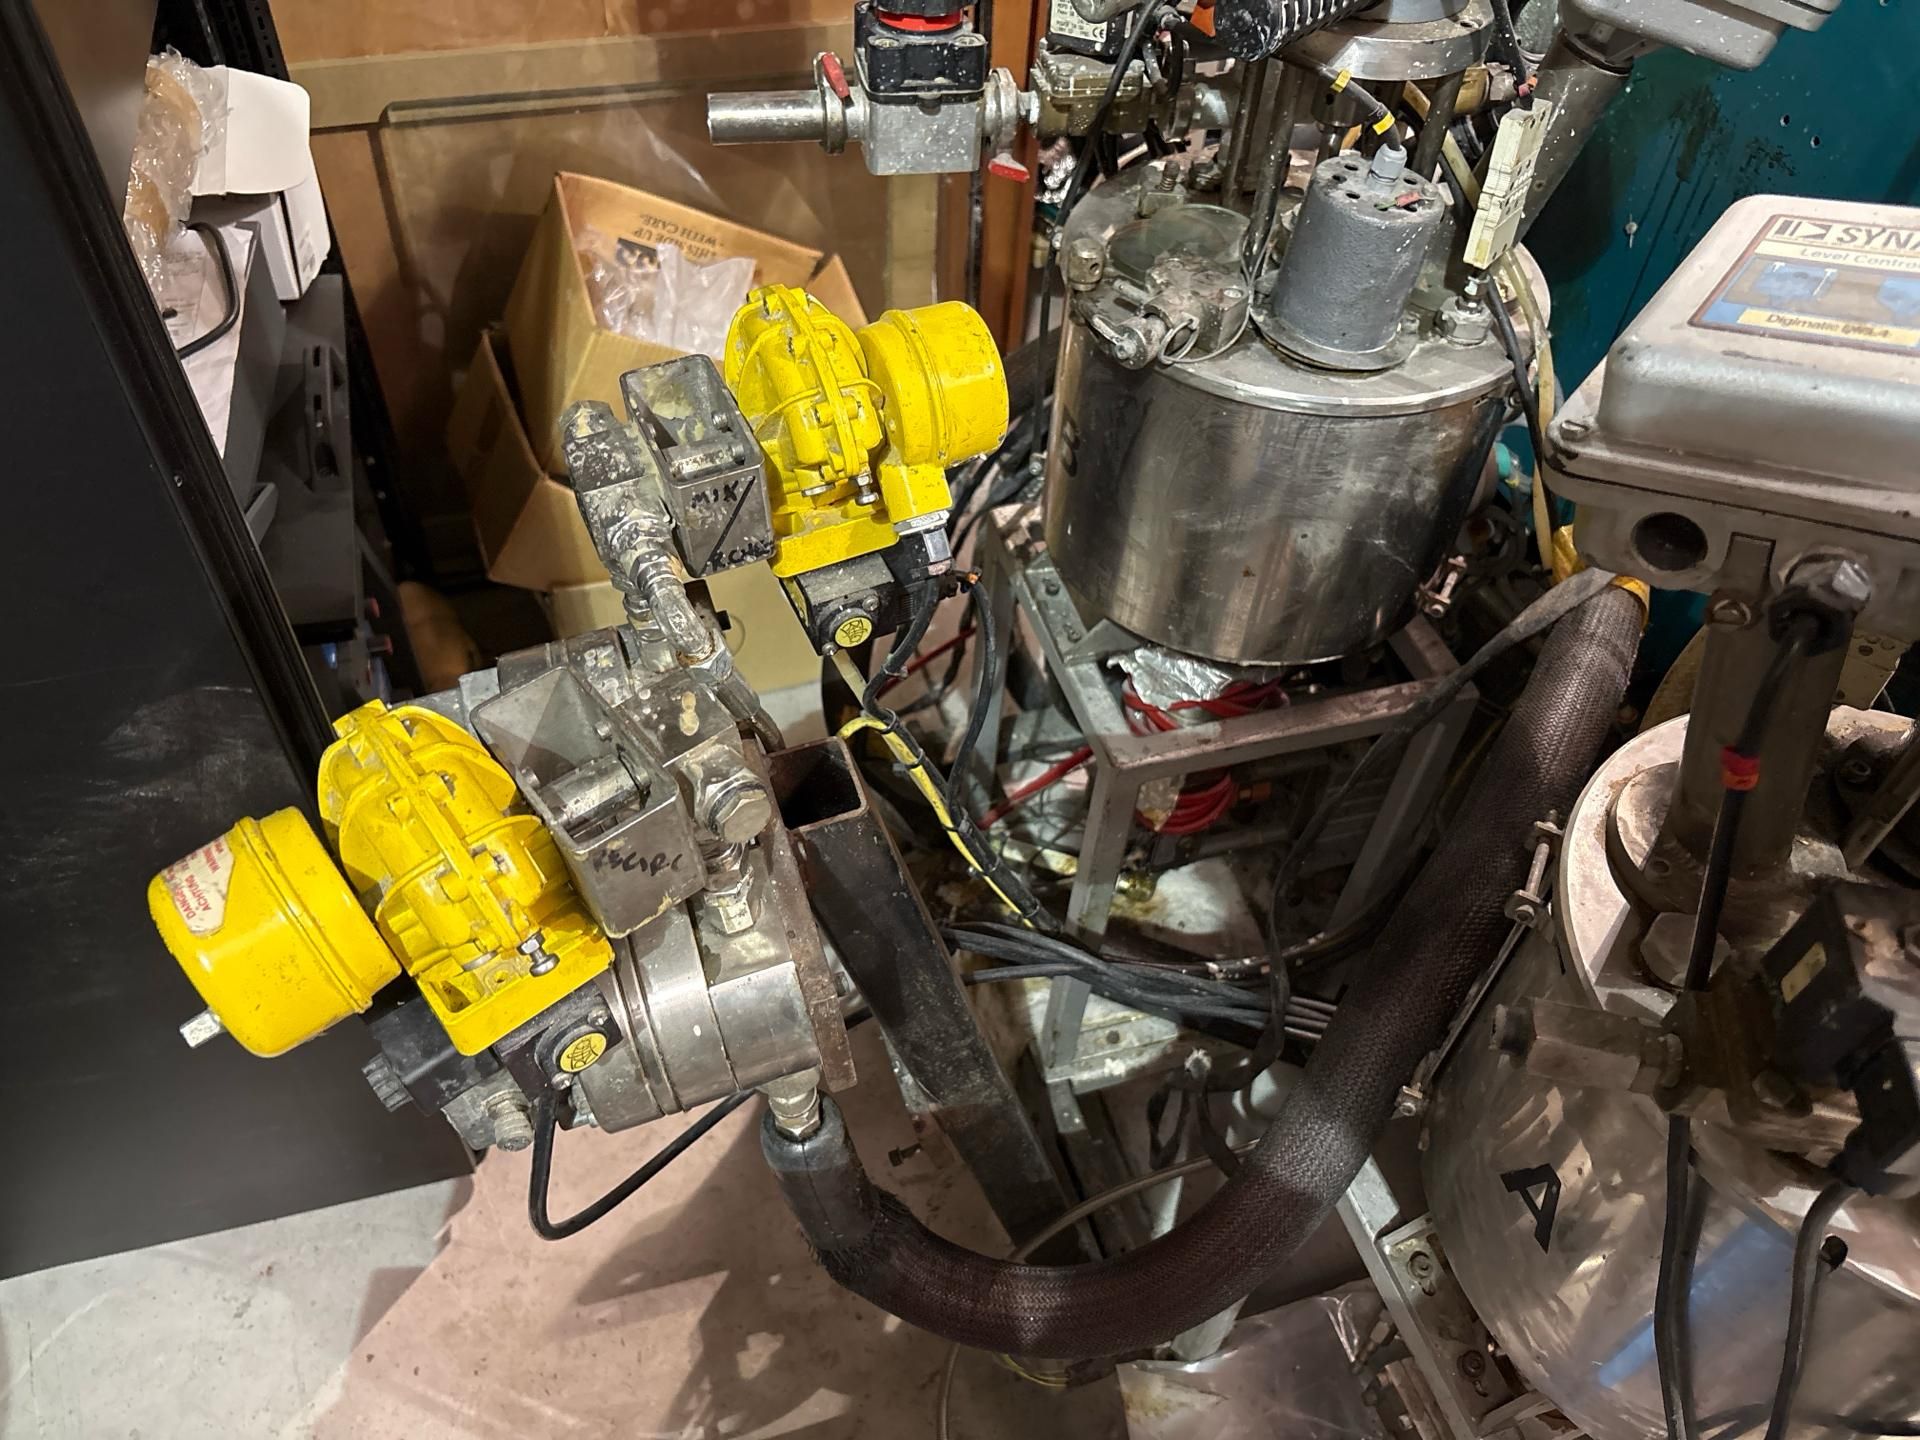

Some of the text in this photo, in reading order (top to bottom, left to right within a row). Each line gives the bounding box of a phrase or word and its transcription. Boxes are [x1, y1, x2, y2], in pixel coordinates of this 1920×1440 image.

[680, 228, 717, 247] WITH
[1800, 248, 1920, 269] Level Contro
[691, 480, 739, 509] MIX
[1500, 1162, 1562, 1254] A
